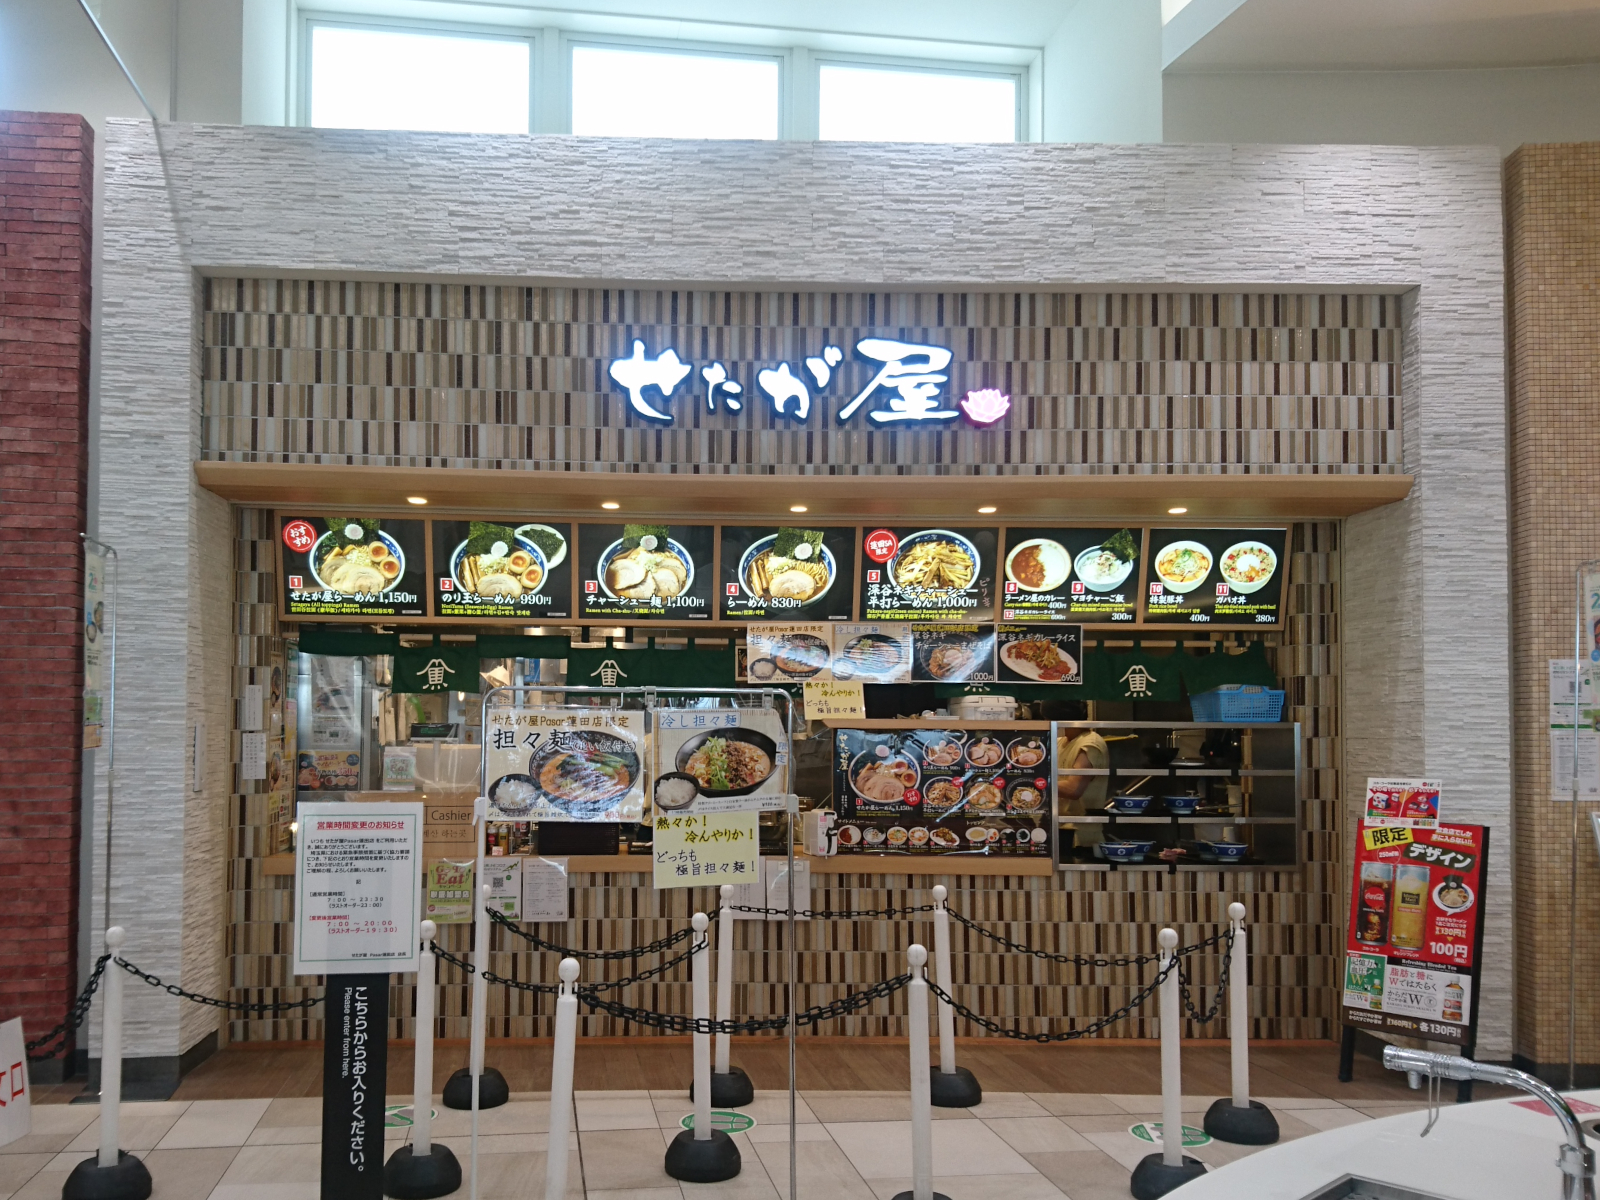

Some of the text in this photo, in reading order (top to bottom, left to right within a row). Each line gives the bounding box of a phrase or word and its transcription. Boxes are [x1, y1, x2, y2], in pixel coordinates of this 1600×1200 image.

[609, 338, 960, 425] せたが屋
[293, 578, 298, 586] 1
[444, 580, 450, 588] 2
[588, 583, 594, 591] 3
[730, 585, 736, 594] 4
[868, 584, 978, 597] 深谷ネギチャーシュー
[291, 591, 417, 603] せたが屋らーめん 1,150円
[442, 592, 551, 605] のり玉らーめん 990円
[586, 594, 704, 607] チャーシュー麺 1,100円
[728, 597, 801, 607] らーめん 830円
[868, 597, 977, 608] 平打らーめん 1,000円
[1004, 594, 1066, 602] ラーメン屋のカレー
[1071, 594, 1125, 603] マヨチャーご飯
[1149, 595, 1184, 604] 特製豚丼
[751, 633, 791, 646] 担々麺
[998, 633, 1076, 642] 深谷ネギカレーライス
[970, 672, 994, 681] 1000円
[1061, 673, 1080, 682] 690円
[492, 715, 629, 728] せたが屋Pasar蓮田店限定
[661, 714, 737, 727] 冷し担々麺
[493, 729, 572, 752] 担々麺
[838, 733, 851, 770] せたが屋
[431, 810, 472, 820] Cashier
[317, 821, 405, 830] 営業時間変更のお知らせ
[656, 815, 706, 830] 熱々か！
[685, 828, 753, 843] 冷んやりか！
[1372, 828, 1408, 846] 限定
[657, 849, 697, 863] どっちも
[1410, 843, 1471, 868] デザイン
[676, 860, 754, 876] 極旨担々麺！
[436, 874, 465, 884] Eat
[1430, 942, 1468, 958] 100円
[1390, 968, 1433, 981] 脂肪と糖に
[1389, 977, 1437, 991] Wではたらく
[344, 987, 352, 1014] Please
[1420, 1022, 1457, 1036] 各130円
[343, 1038, 351, 1057] from
[342, 1058, 350, 1078] here.
[350, 986, 368, 1172] こちらからお入りください。
